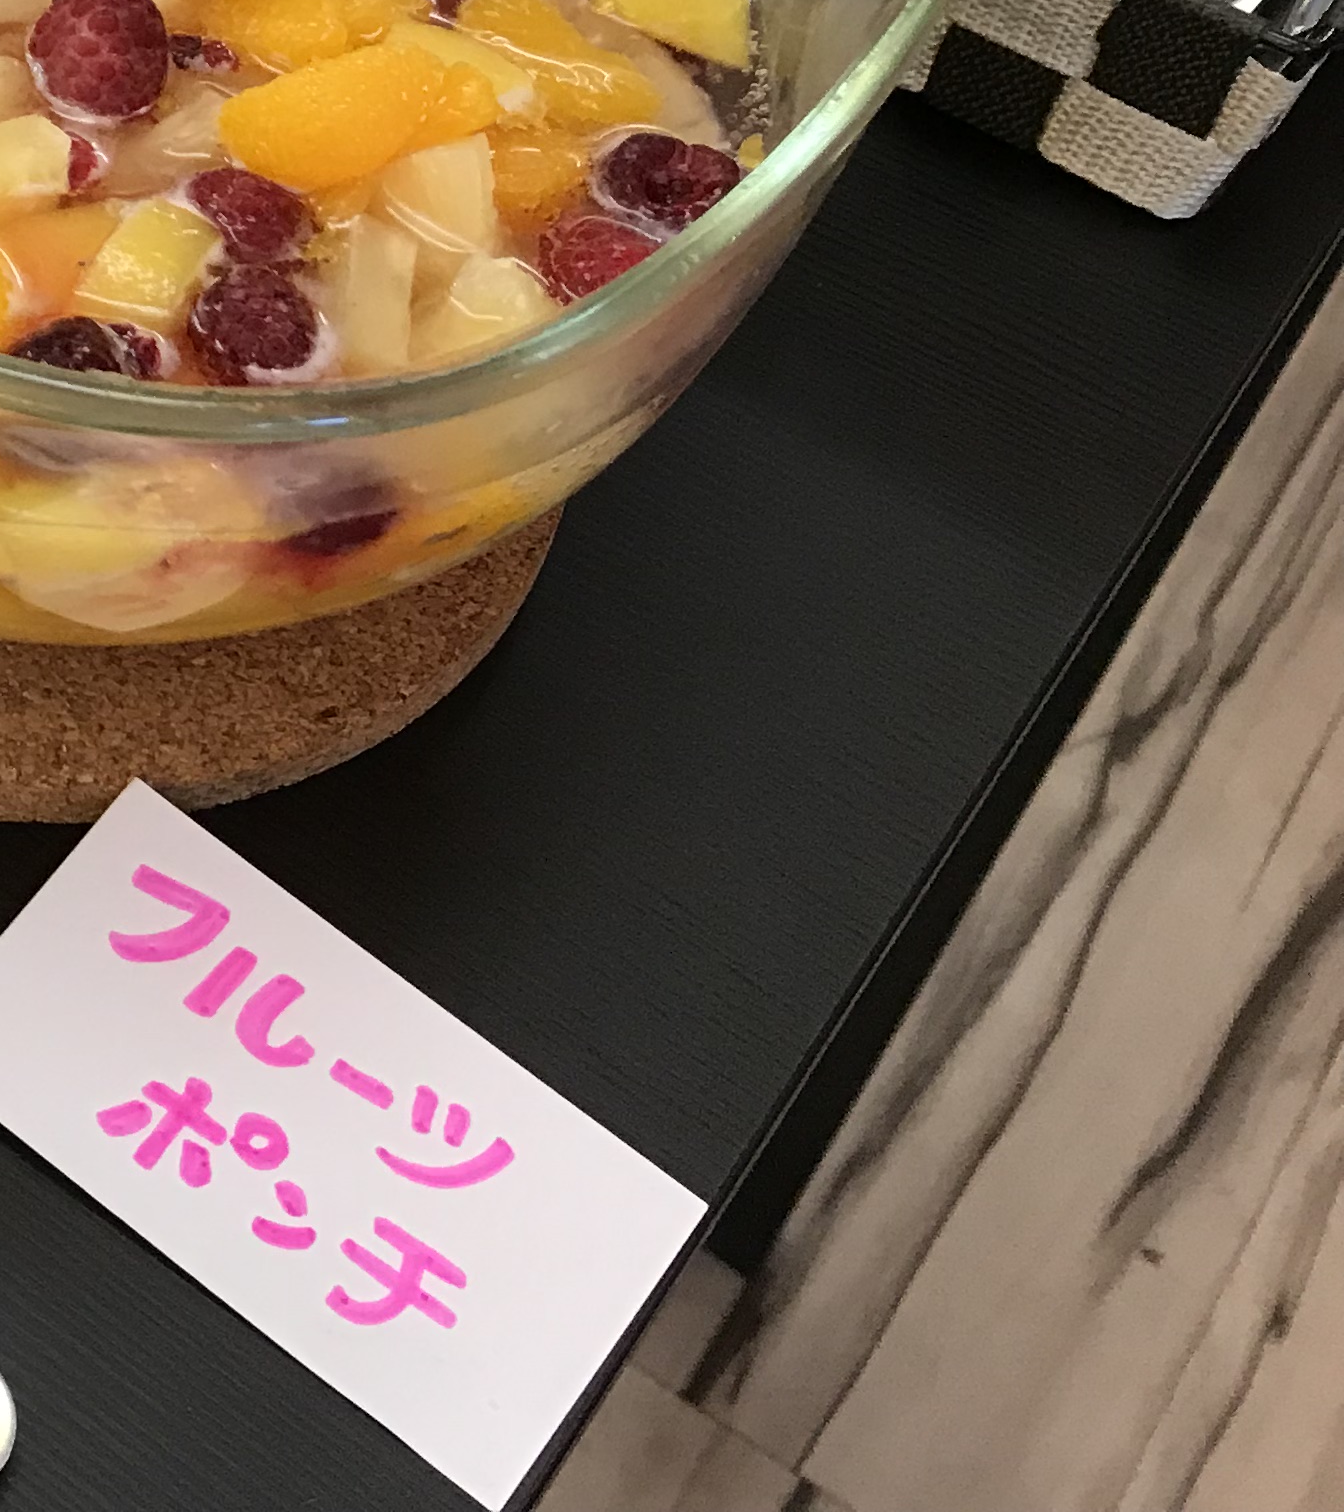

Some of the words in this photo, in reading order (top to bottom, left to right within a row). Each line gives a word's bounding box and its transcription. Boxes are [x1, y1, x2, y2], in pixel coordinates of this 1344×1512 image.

[107, 862, 516, 1190] フルーツ
[95, 1075, 469, 1330] ポンチ
